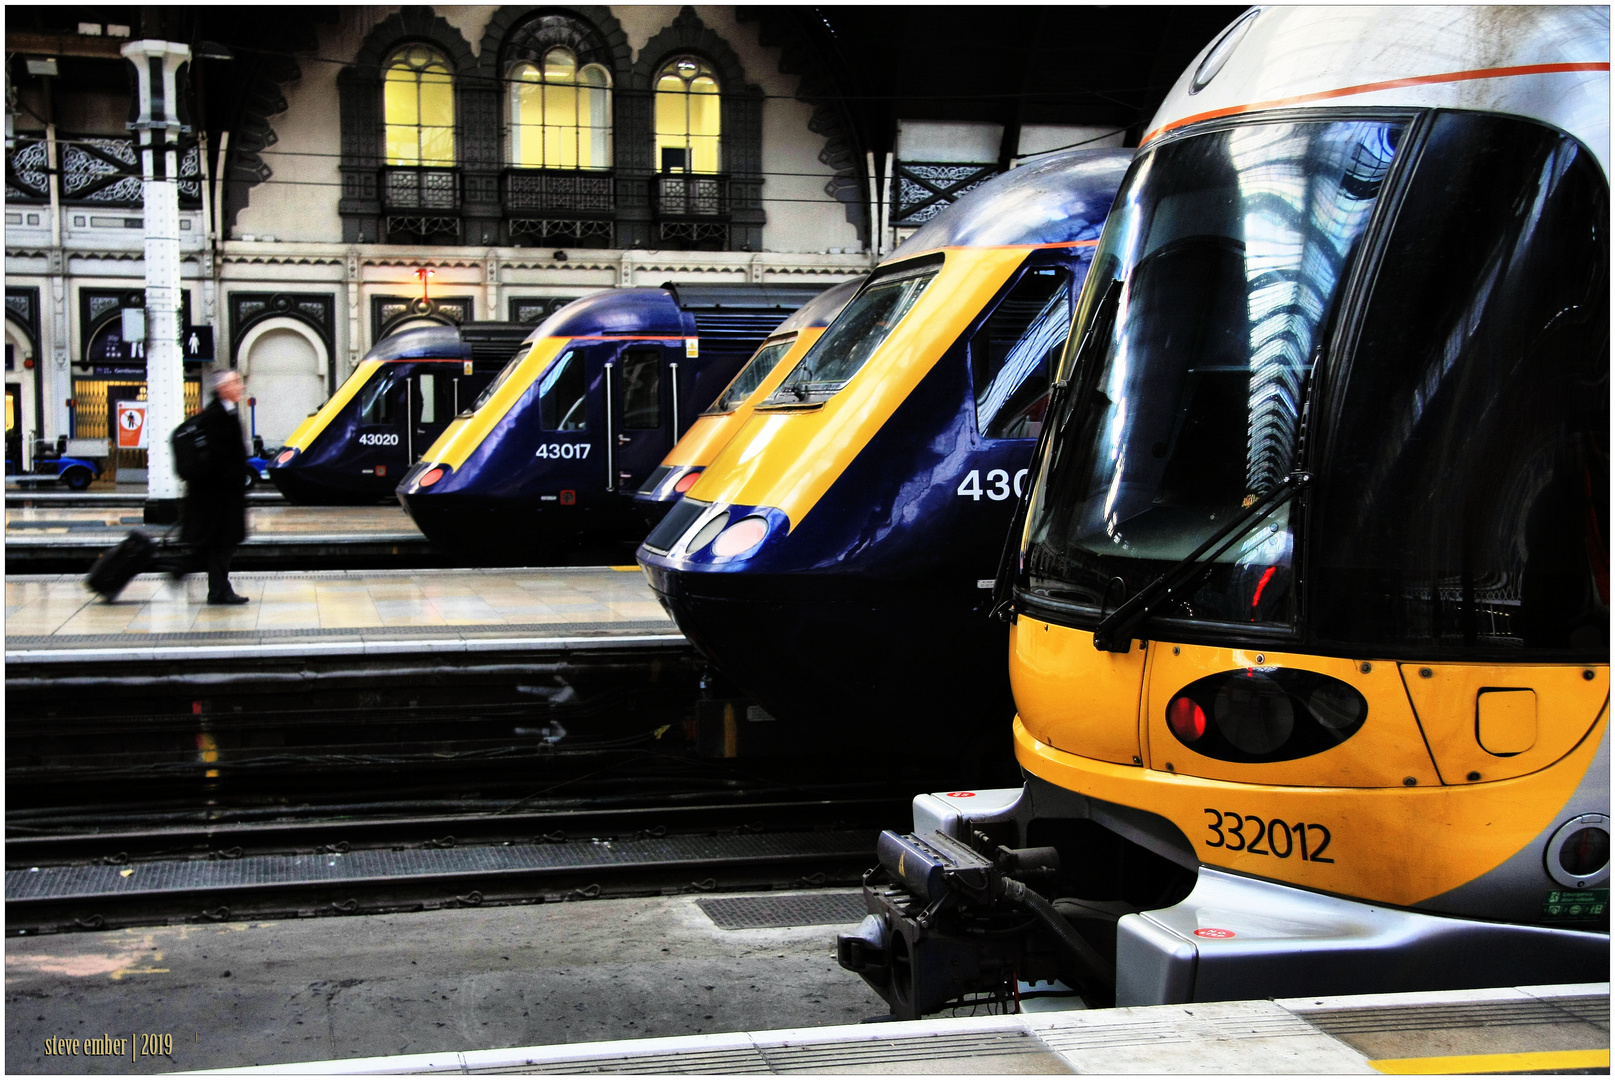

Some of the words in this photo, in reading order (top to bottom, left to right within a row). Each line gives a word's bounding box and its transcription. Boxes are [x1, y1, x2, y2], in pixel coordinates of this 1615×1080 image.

[359, 433, 399, 446] 43020
[535, 443, 592, 459] 43017
[1204, 808, 1335, 864] 332012
